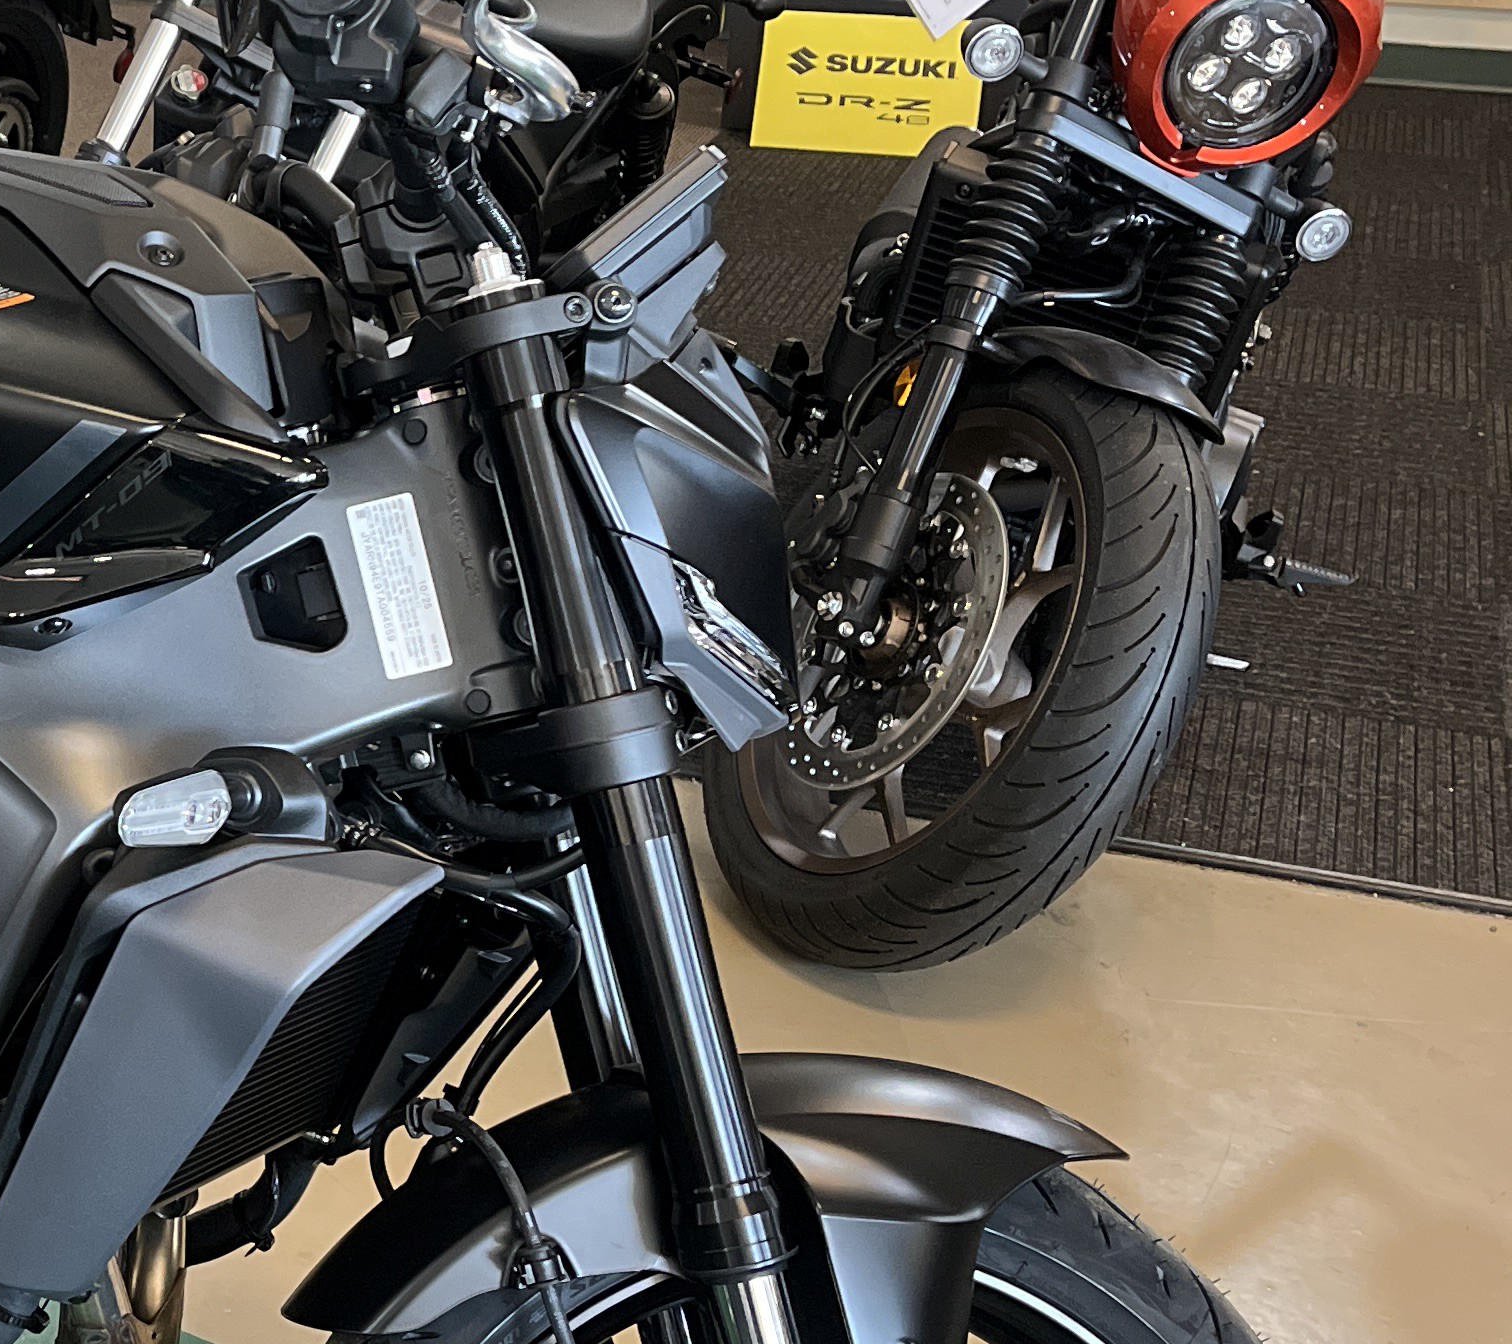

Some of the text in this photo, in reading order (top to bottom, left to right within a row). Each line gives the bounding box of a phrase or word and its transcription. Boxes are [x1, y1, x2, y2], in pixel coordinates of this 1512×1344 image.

[826, 53, 957, 80] SUZUKI
[796, 91, 931, 112] DR-Z
[54, 448, 174, 561] MT-09
